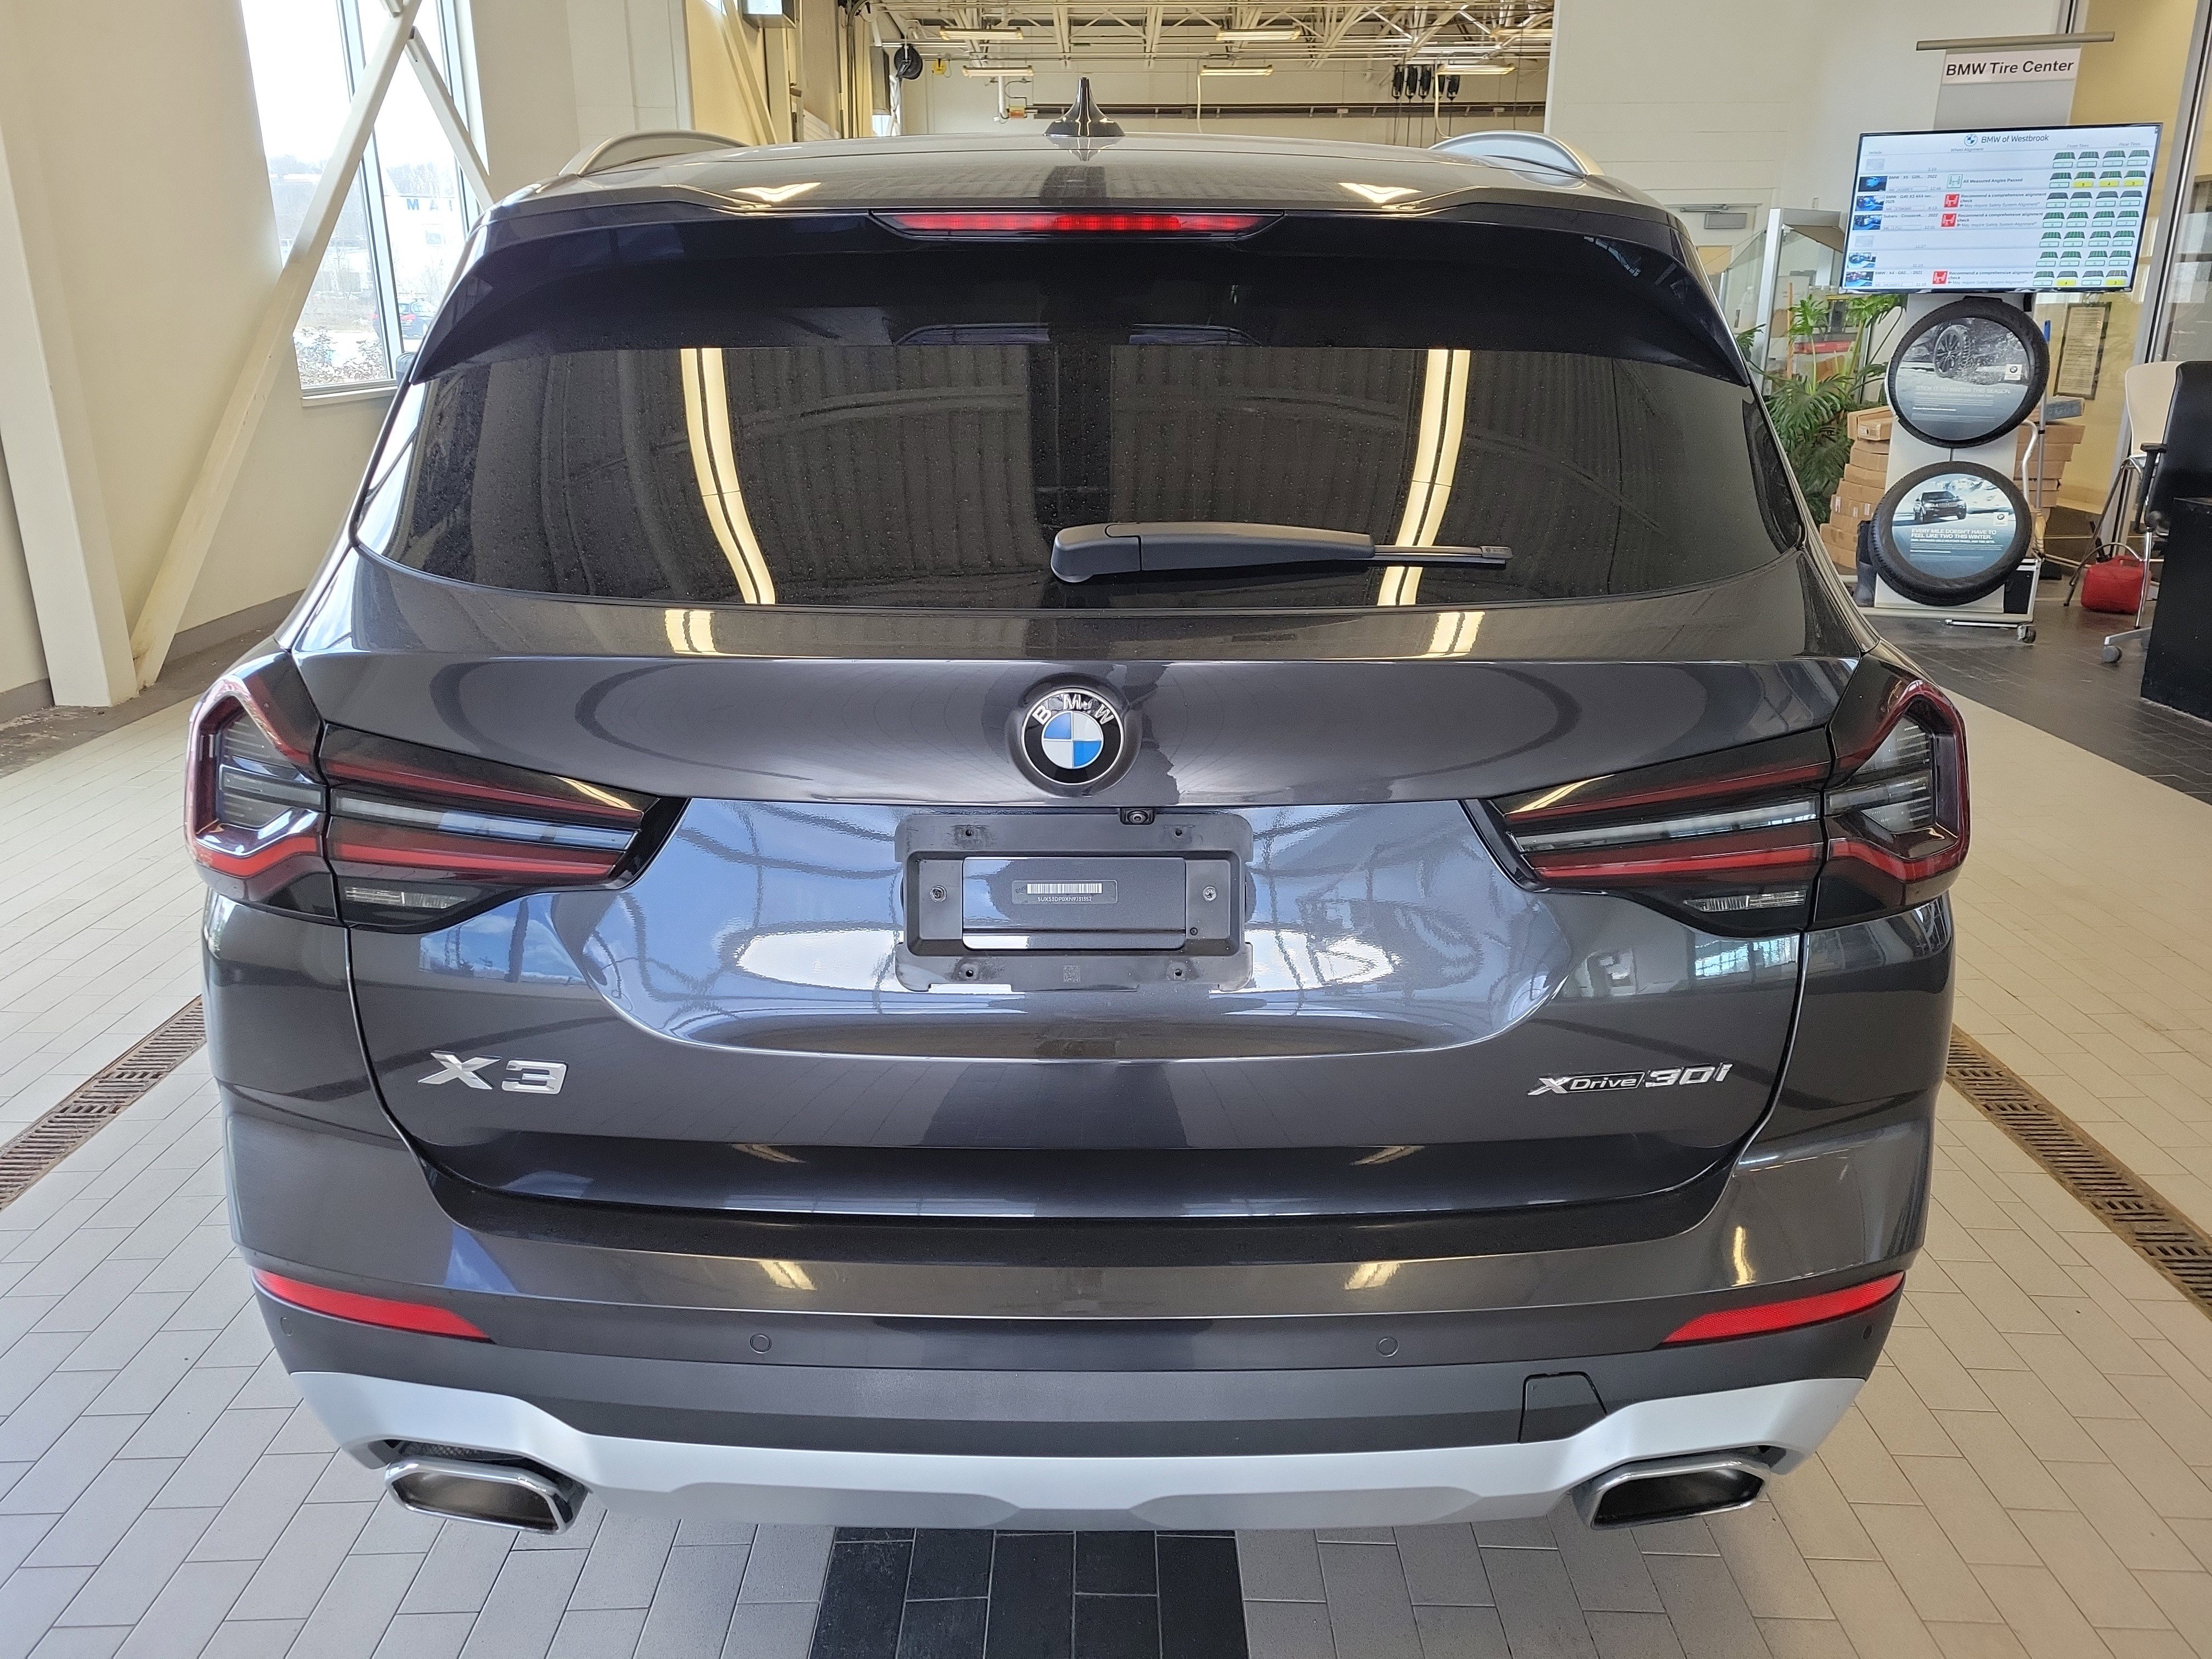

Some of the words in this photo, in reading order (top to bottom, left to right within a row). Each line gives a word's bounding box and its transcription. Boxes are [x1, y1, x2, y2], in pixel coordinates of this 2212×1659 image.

[1946, 63, 1987, 76] BMW
[1989, 61, 2018, 74] Tire
[2023, 60, 2074, 72] Center
[1032, 693, 1114, 725] BMW
[417, 1050, 568, 1094] X3
